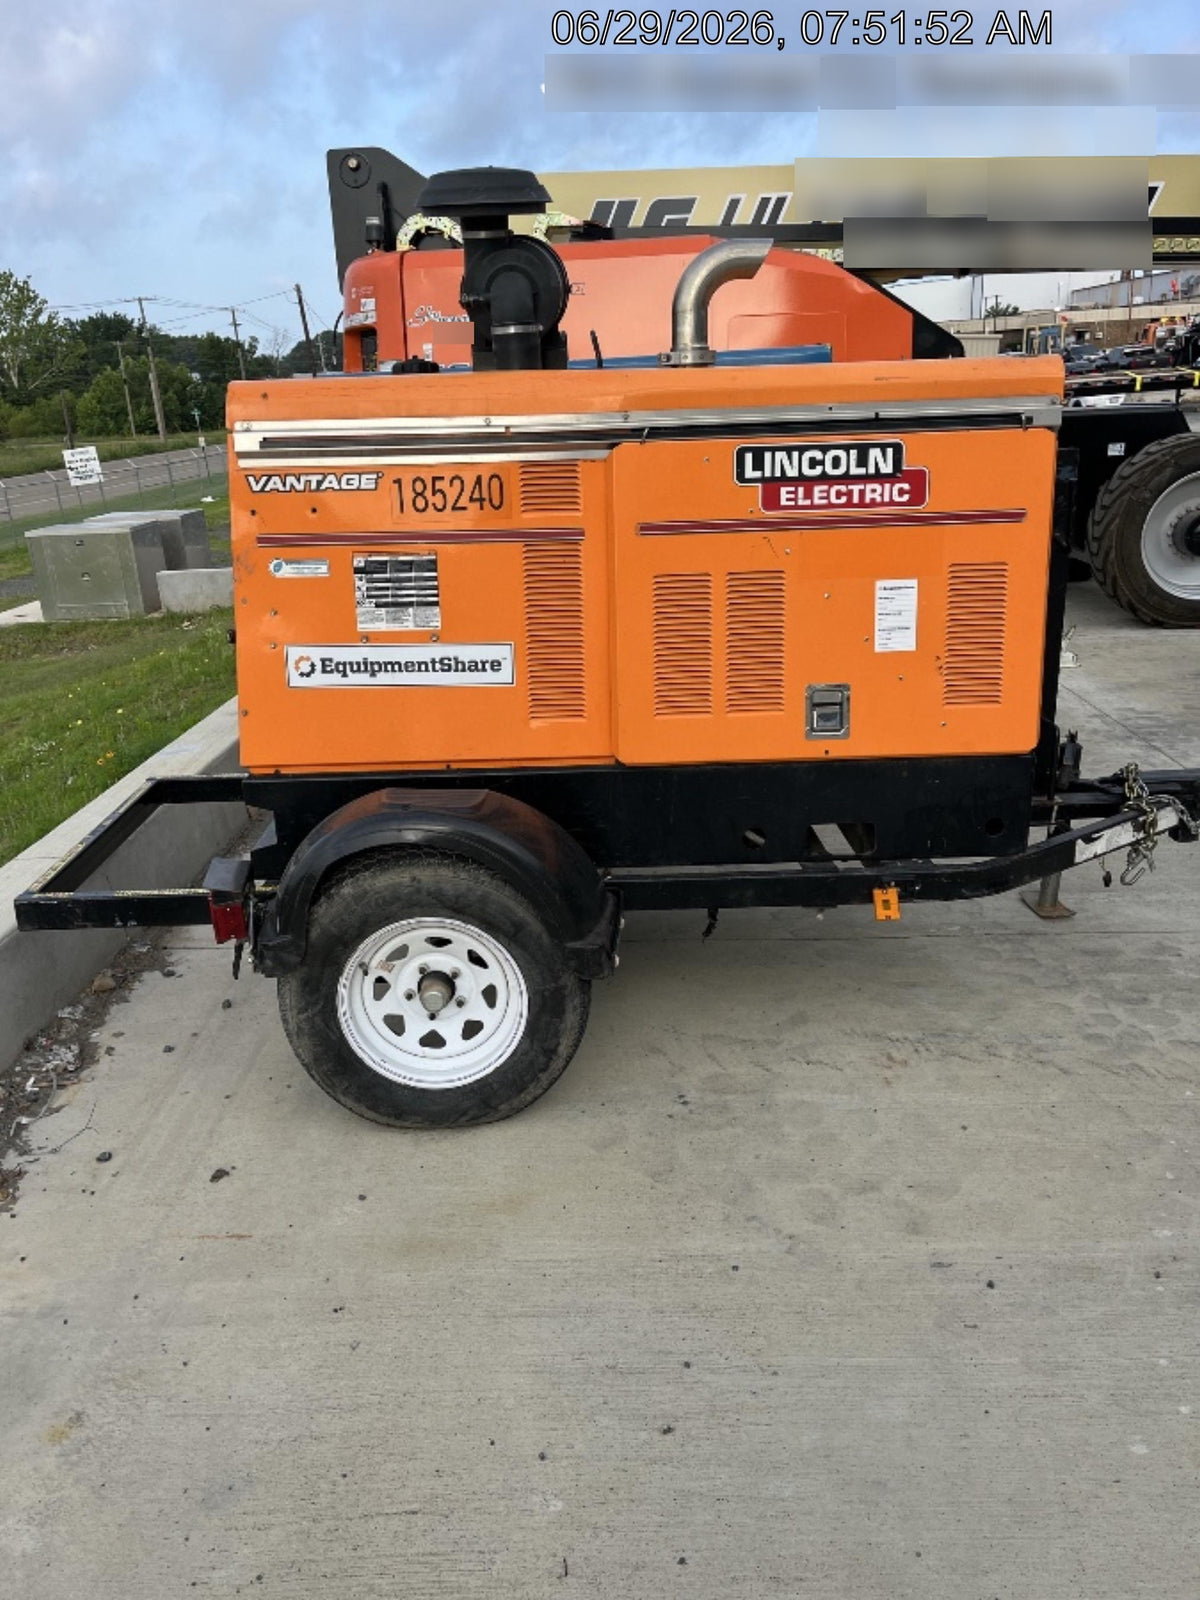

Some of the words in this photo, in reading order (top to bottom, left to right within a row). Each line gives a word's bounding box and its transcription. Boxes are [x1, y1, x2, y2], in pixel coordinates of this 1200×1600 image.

[744, 447, 894, 479] LINCOLN
[246, 472, 379, 493] VANTAGE
[392, 473, 504, 513] 185240
[780, 482, 911, 506] ELECTRIC
[319, 656, 502, 678] EquipmentShare
